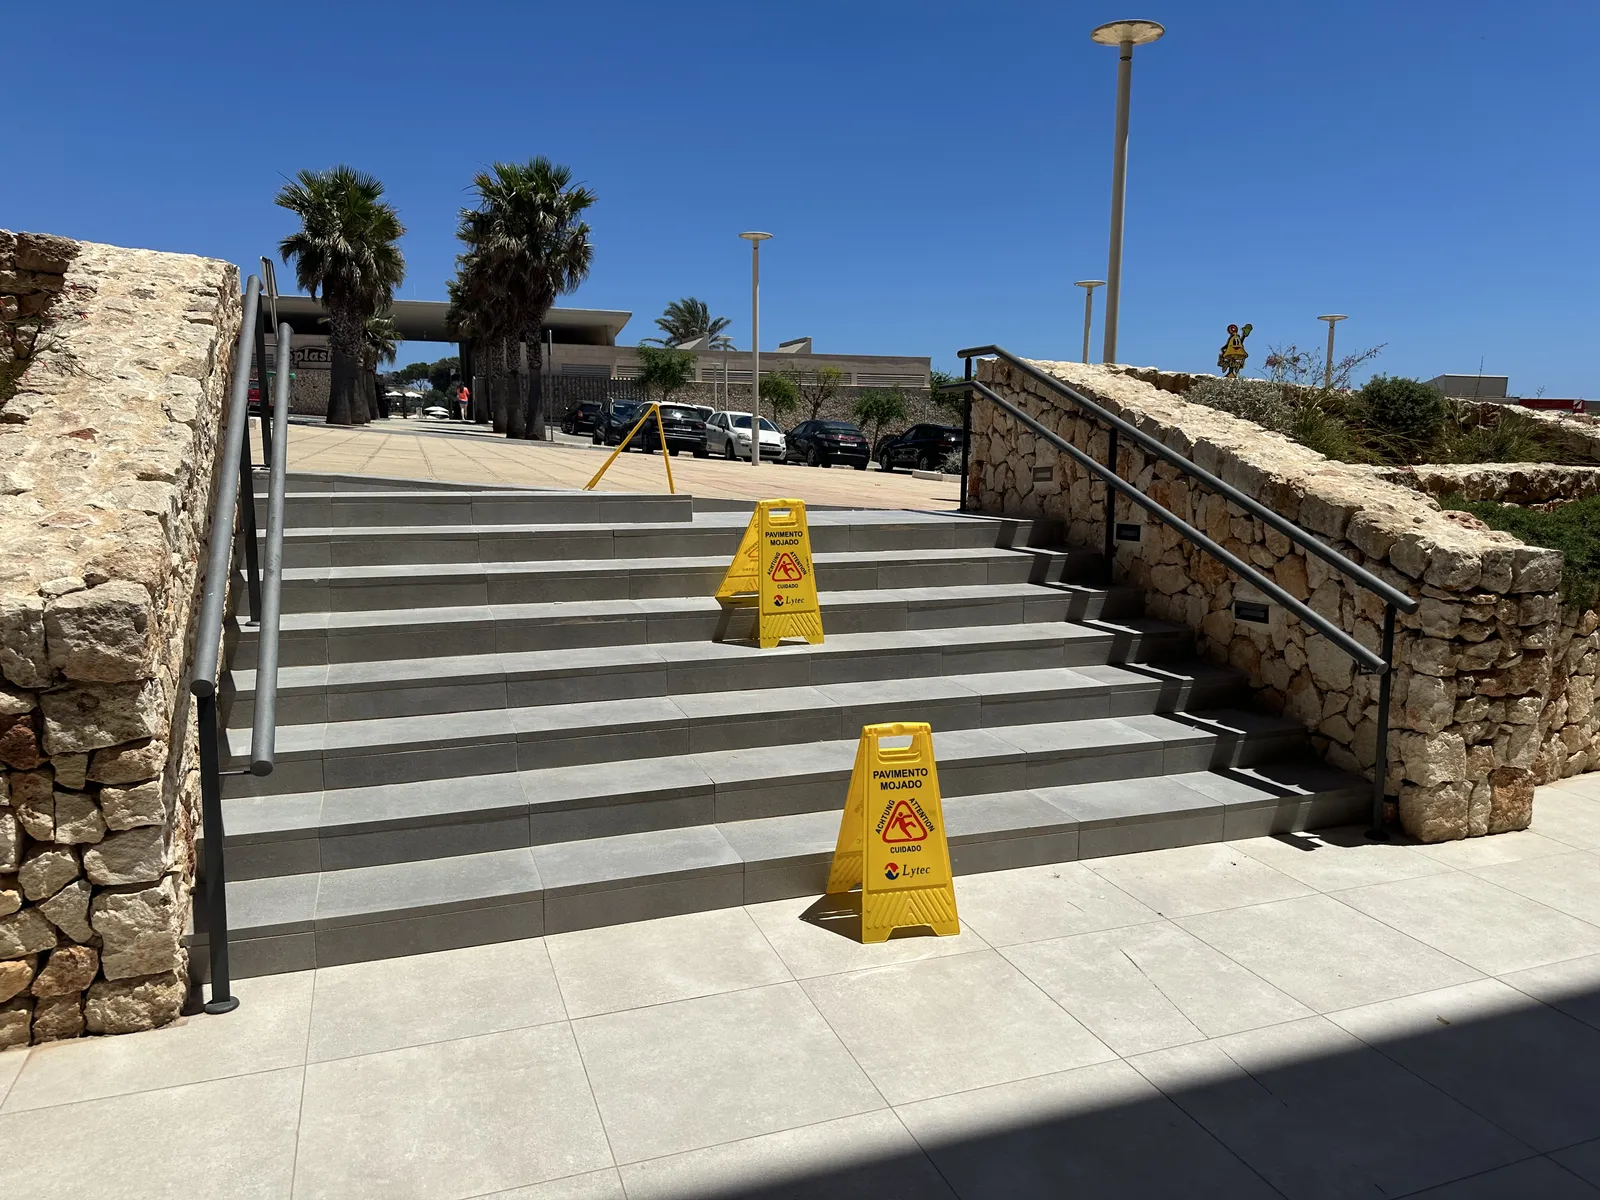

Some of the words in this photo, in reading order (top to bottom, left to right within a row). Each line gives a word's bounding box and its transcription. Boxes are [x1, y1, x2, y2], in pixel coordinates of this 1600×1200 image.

[290, 347, 332, 364] plas
[767, 552, 781, 576] ACHTUNG
[790, 551, 807, 576] ATTENTION
[785, 596, 804, 606] Lytec
[873, 768, 928, 779] PAVIMENTO
[880, 780, 922, 790] MOJADO
[875, 799, 896, 834] ACHTUNG
[909, 798, 936, 832] ATTENTION
[890, 845, 921, 854] CUIDADO
[902, 864, 931, 878] Lytec
